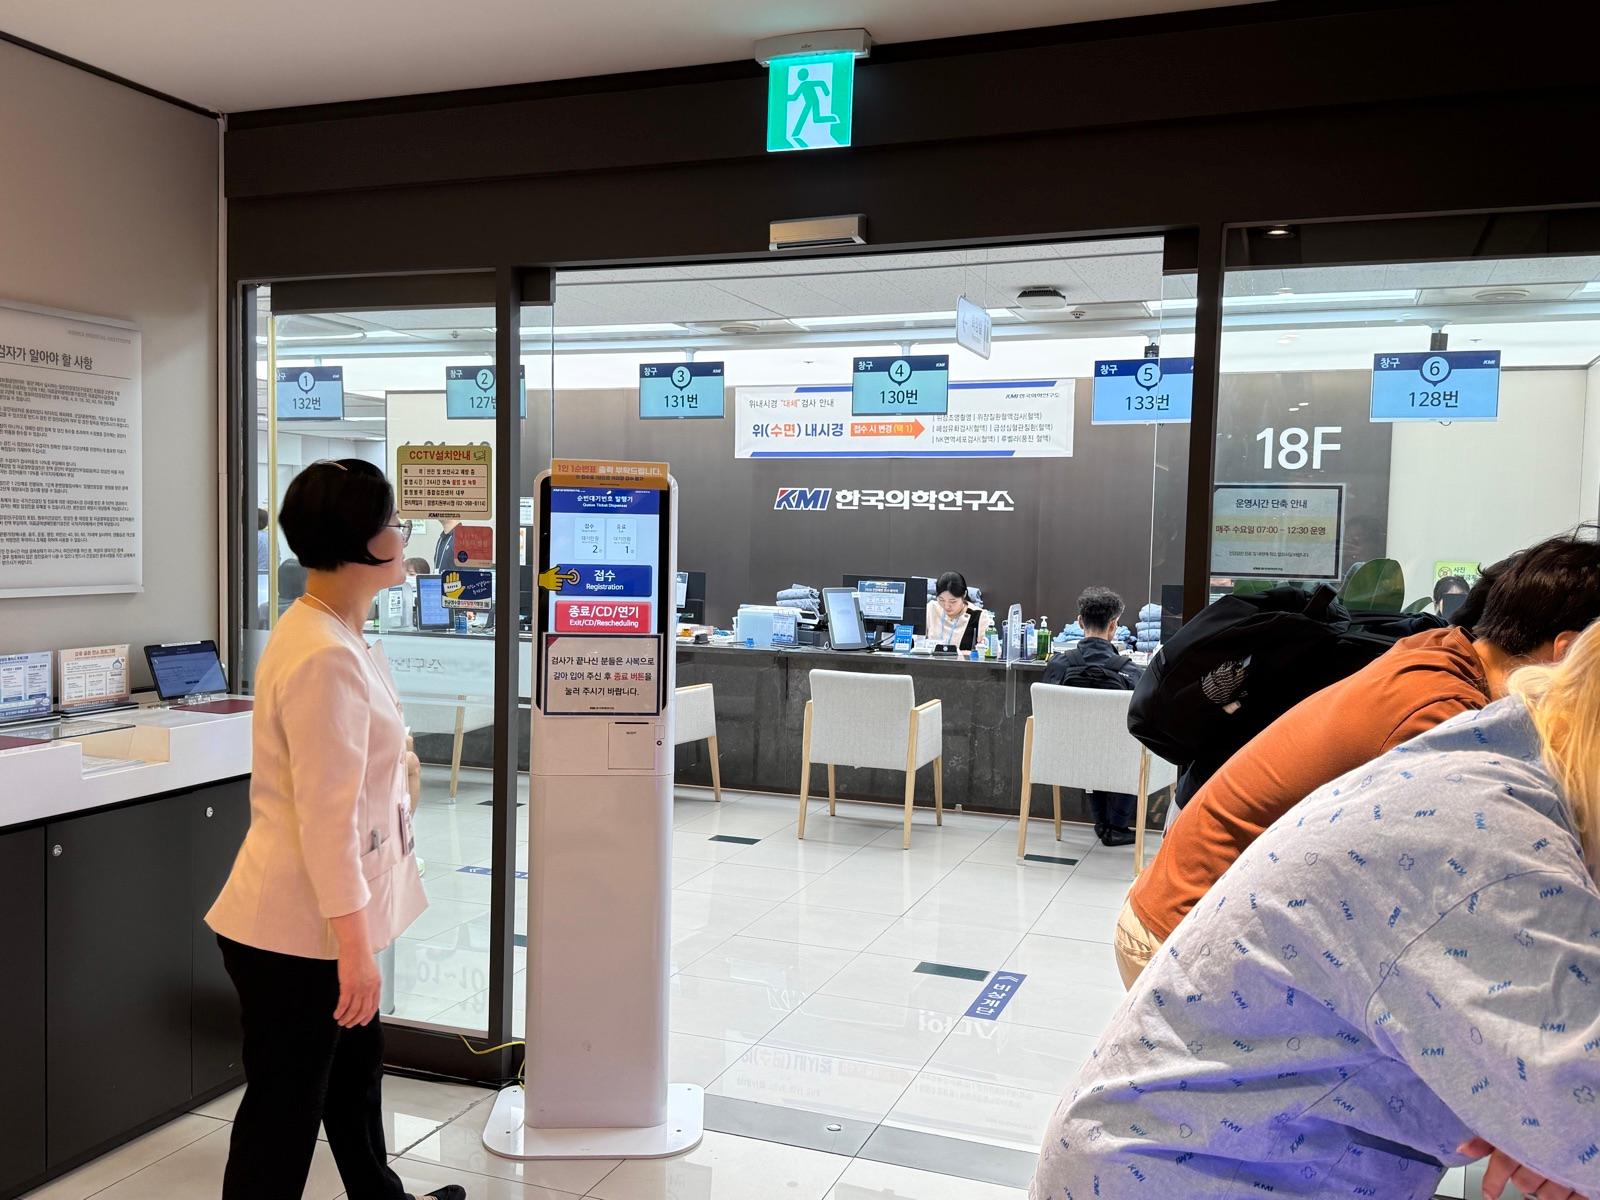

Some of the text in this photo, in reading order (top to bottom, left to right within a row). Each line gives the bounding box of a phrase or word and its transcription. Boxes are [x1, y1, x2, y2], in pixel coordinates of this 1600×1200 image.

[29, 348, 59, 366] 알아야
[62, 353, 72, 368] 할
[73, 356, 94, 370] 사항
[1380, 357, 1400, 368] 창구
[643, 367, 657, 377] 창구
[858, 361, 873, 371] 창구
[895, 364, 904, 377] 4
[1100, 364, 1118, 375] 창구
[1429, 361, 1440, 376] 6
[481, 372, 488, 385] 2
[677, 370, 685, 382] 3
[1143, 368, 1153, 381] 5
[303, 375, 309, 388] 1
[664, 394, 698, 408] 131번
[880, 389, 918, 405] 130번
[1125, 394, 1169, 411] 133번
[1409, 390, 1459, 408] 128번
[292, 398, 321, 411] 132번
[749, 400, 778, 409] 위내시경
[801, 399, 816, 408] 검사
[819, 399, 834, 408] 안내
[752, 423, 844, 438] 위(수면) 내시경
[870, 424, 877, 433] 시
[1256, 426, 1343, 470] 18F
[409, 449, 471, 461] CCTV설치안내
[774, 487, 1015, 512] KMI 한국의학연구소
[1235, 499, 1308, 509] 운영시간 단축 안내
[1215, 525, 1326, 536] 매주 수요일 07:00 12:30 운영
[592, 544, 599, 554] 2
[593, 569, 616, 582] 접수
[586, 583, 624, 591] Registration
[568, 605, 639, 619] 종료/CD/연기
[569, 619, 639, 628] Exit/CD/Rescheduling
[551, 656, 574, 666] 검사가
[576, 656, 599, 667] 끝나신
[600, 656, 624, 667] 분들은
[553, 671, 652, 682] 갈아 입어 주신 후 종료 버튼을
[564, 687, 640, 697] 눌러 주시기 바랍니다.
[1348, 850, 1366, 867] KMI
[1447, 858, 1468, 877] KMI
[1539, 886, 1564, 899] KMI
[1287, 899, 1307, 909] KMI
[1340, 900, 1354, 921] KMI
[1233, 939, 1249, 956] KMI
[1444, 947, 1468, 958] KMI
[1322, 950, 1343, 968] KMI
[976, 983, 1012, 1016] 비상계단
[1152, 988, 1166, 1008] KMI
[1232, 990, 1248, 1010] KMI
[1540, 1023, 1565, 1033] KMI
[1139, 1035, 1156, 1051] KMI
[1336, 1030, 1360, 1044] KMI
[1421, 1047, 1444, 1057] KMI
[1472, 1077, 1490, 1094] KMI
[1220, 1118, 1242, 1133] KMI
[1521, 1117, 1541, 1128] KMI
[1578, 1144, 1600, 1165] KMI
[1128, 1164, 1146, 1183] KMI
[1253, 1181, 1274, 1192] KMI
